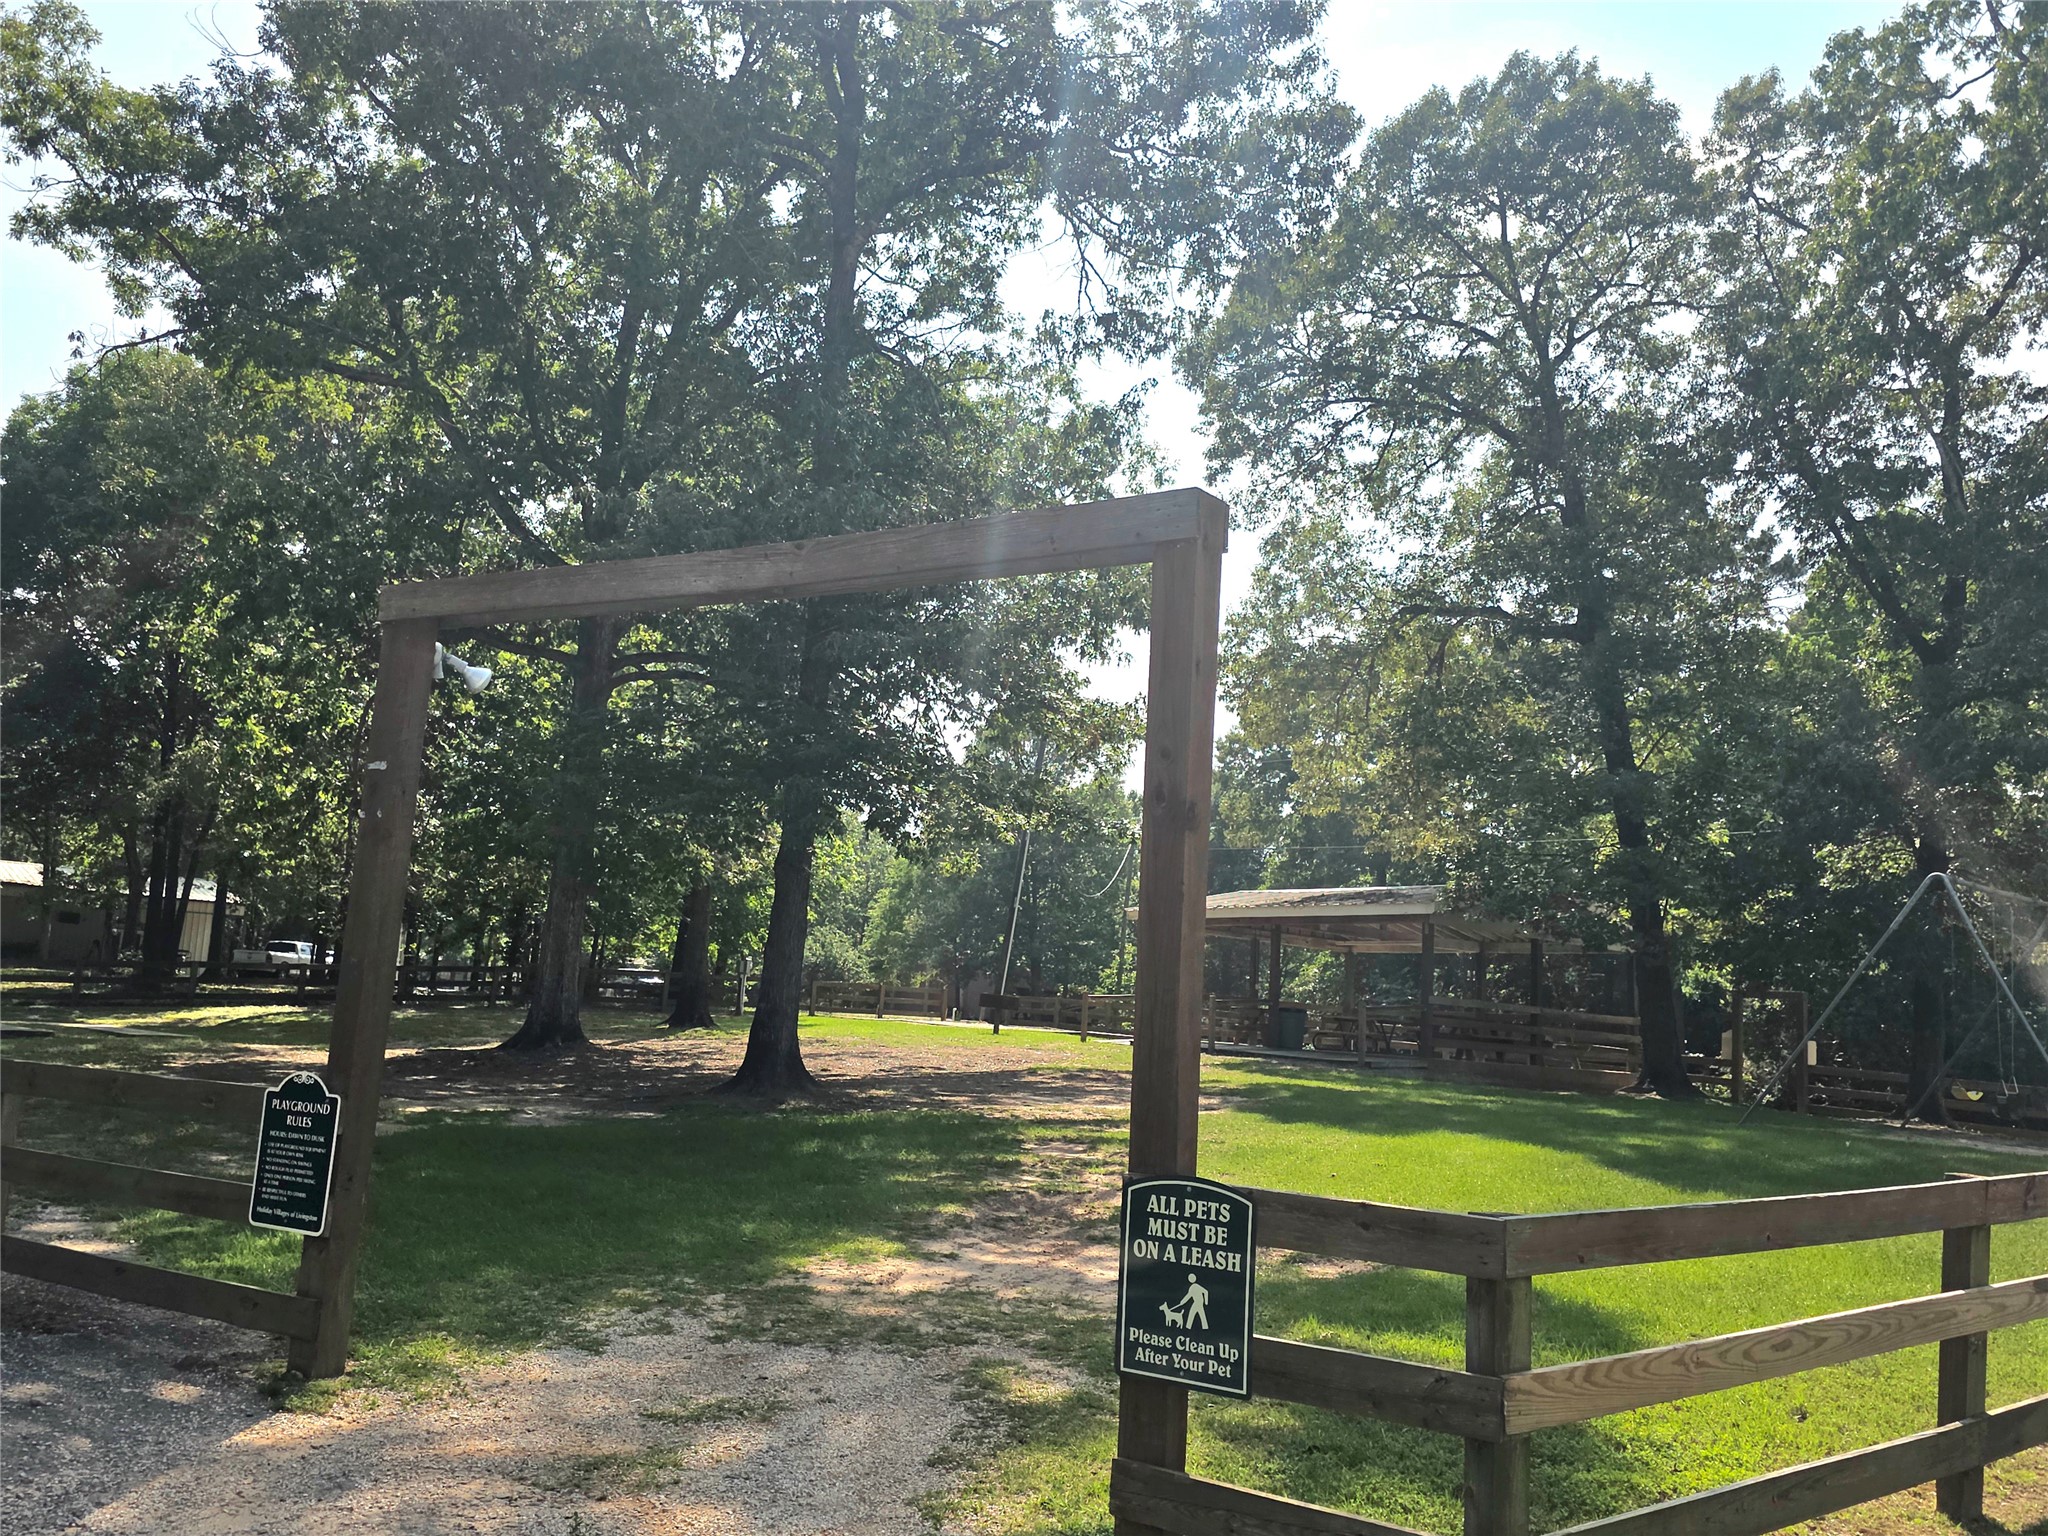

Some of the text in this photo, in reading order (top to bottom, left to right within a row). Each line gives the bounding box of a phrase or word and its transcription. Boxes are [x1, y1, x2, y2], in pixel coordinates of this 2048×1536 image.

[272, 1099, 330, 1114] PLAYGROUND
[286, 1115, 312, 1127] RULES
[1146, 1194, 1231, 1223] ALL PETS
[1147, 1218, 1228, 1246] MUST BE
[1133, 1239, 1241, 1272] ON A LEASH
[1129, 1327, 1239, 1363] Please Clean Up
[1134, 1347, 1232, 1378] After Your Pet
